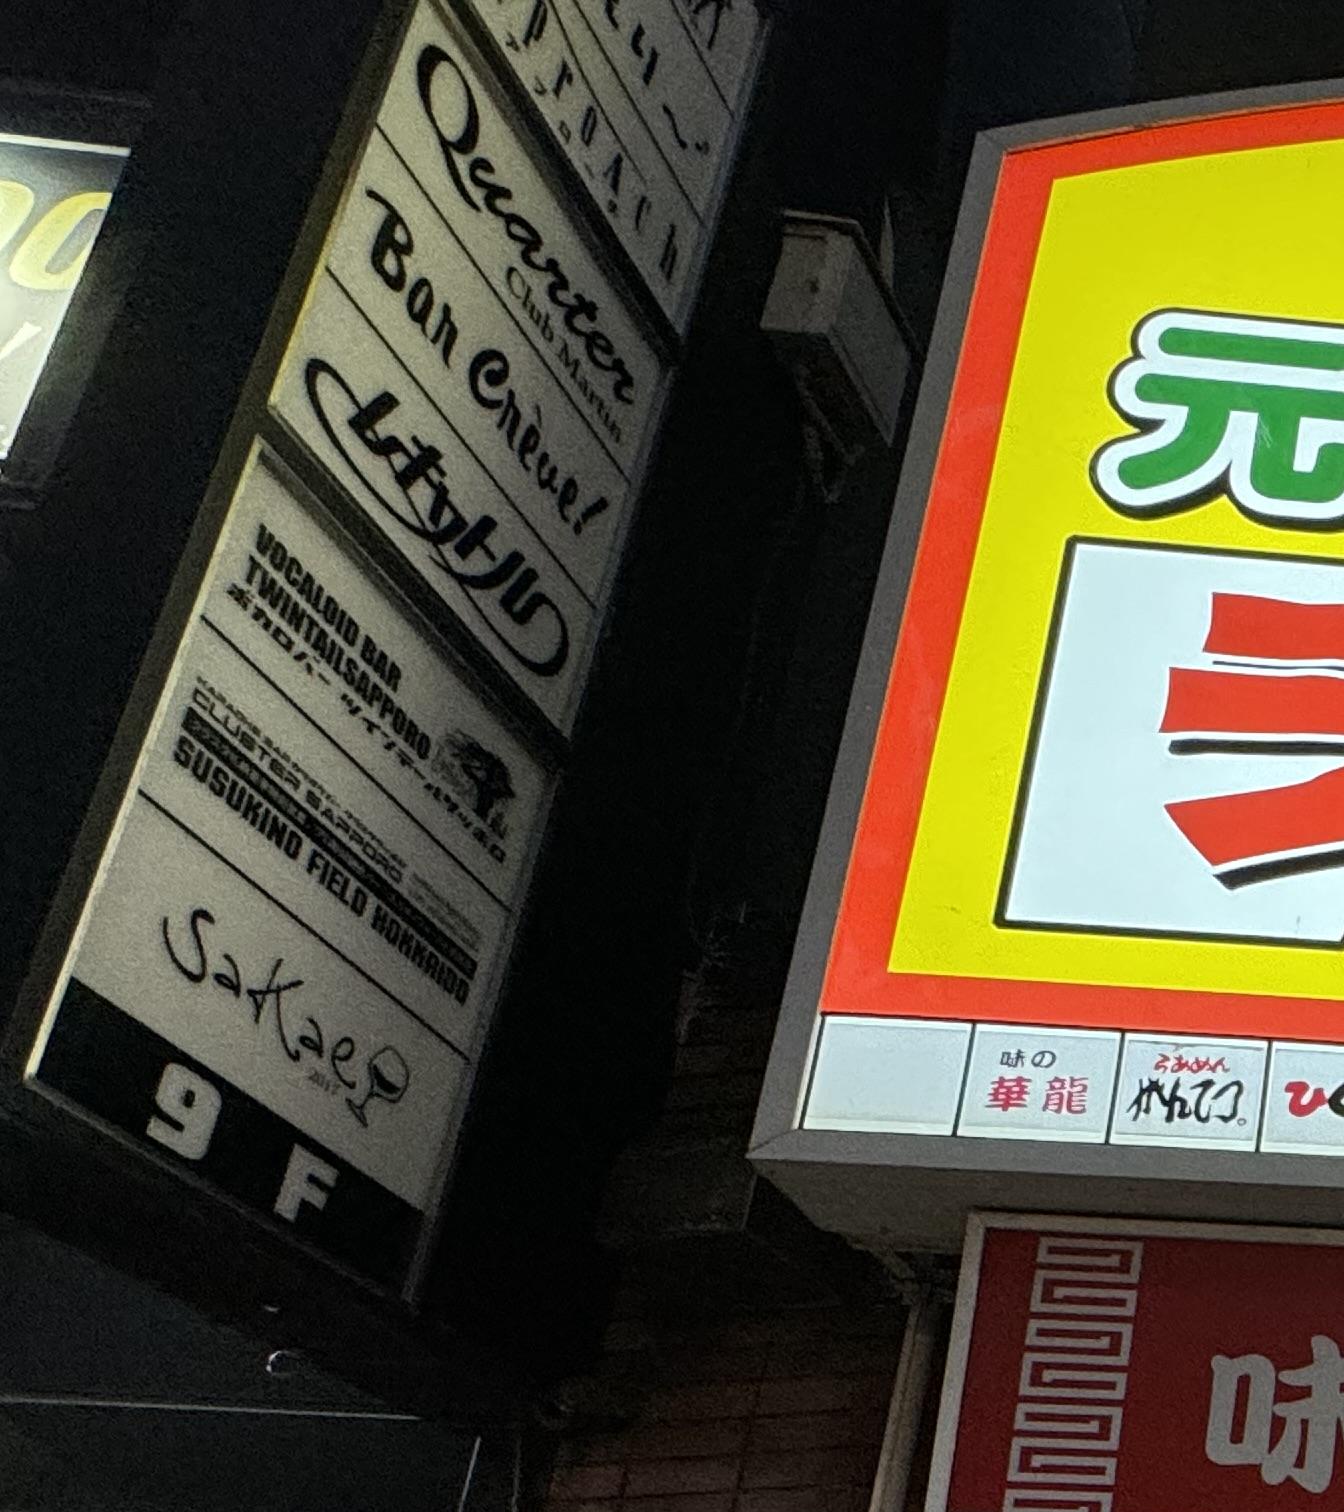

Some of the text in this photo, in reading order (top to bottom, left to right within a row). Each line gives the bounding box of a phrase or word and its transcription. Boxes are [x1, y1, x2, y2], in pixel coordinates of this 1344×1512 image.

[365, 188, 460, 370] Bar
[417, 43, 636, 406] Quarter
[503, 265, 625, 446] Club Martin
[238, 552, 435, 763] TWINTAILSAPPORO
[249, 520, 403, 694] VOCALOID BAR
[189, 686, 302, 795] CLUSTER
[304, 787, 404, 886] SAPPORO
[305, 848, 370, 920] FIELD
[146, 1061, 340, 1223] 9 F
[985, 1076, 1090, 1115] 華龍
[1000, 1050, 1057, 1069] 味の
[1154, 1052, 1231, 1074] らあめん
